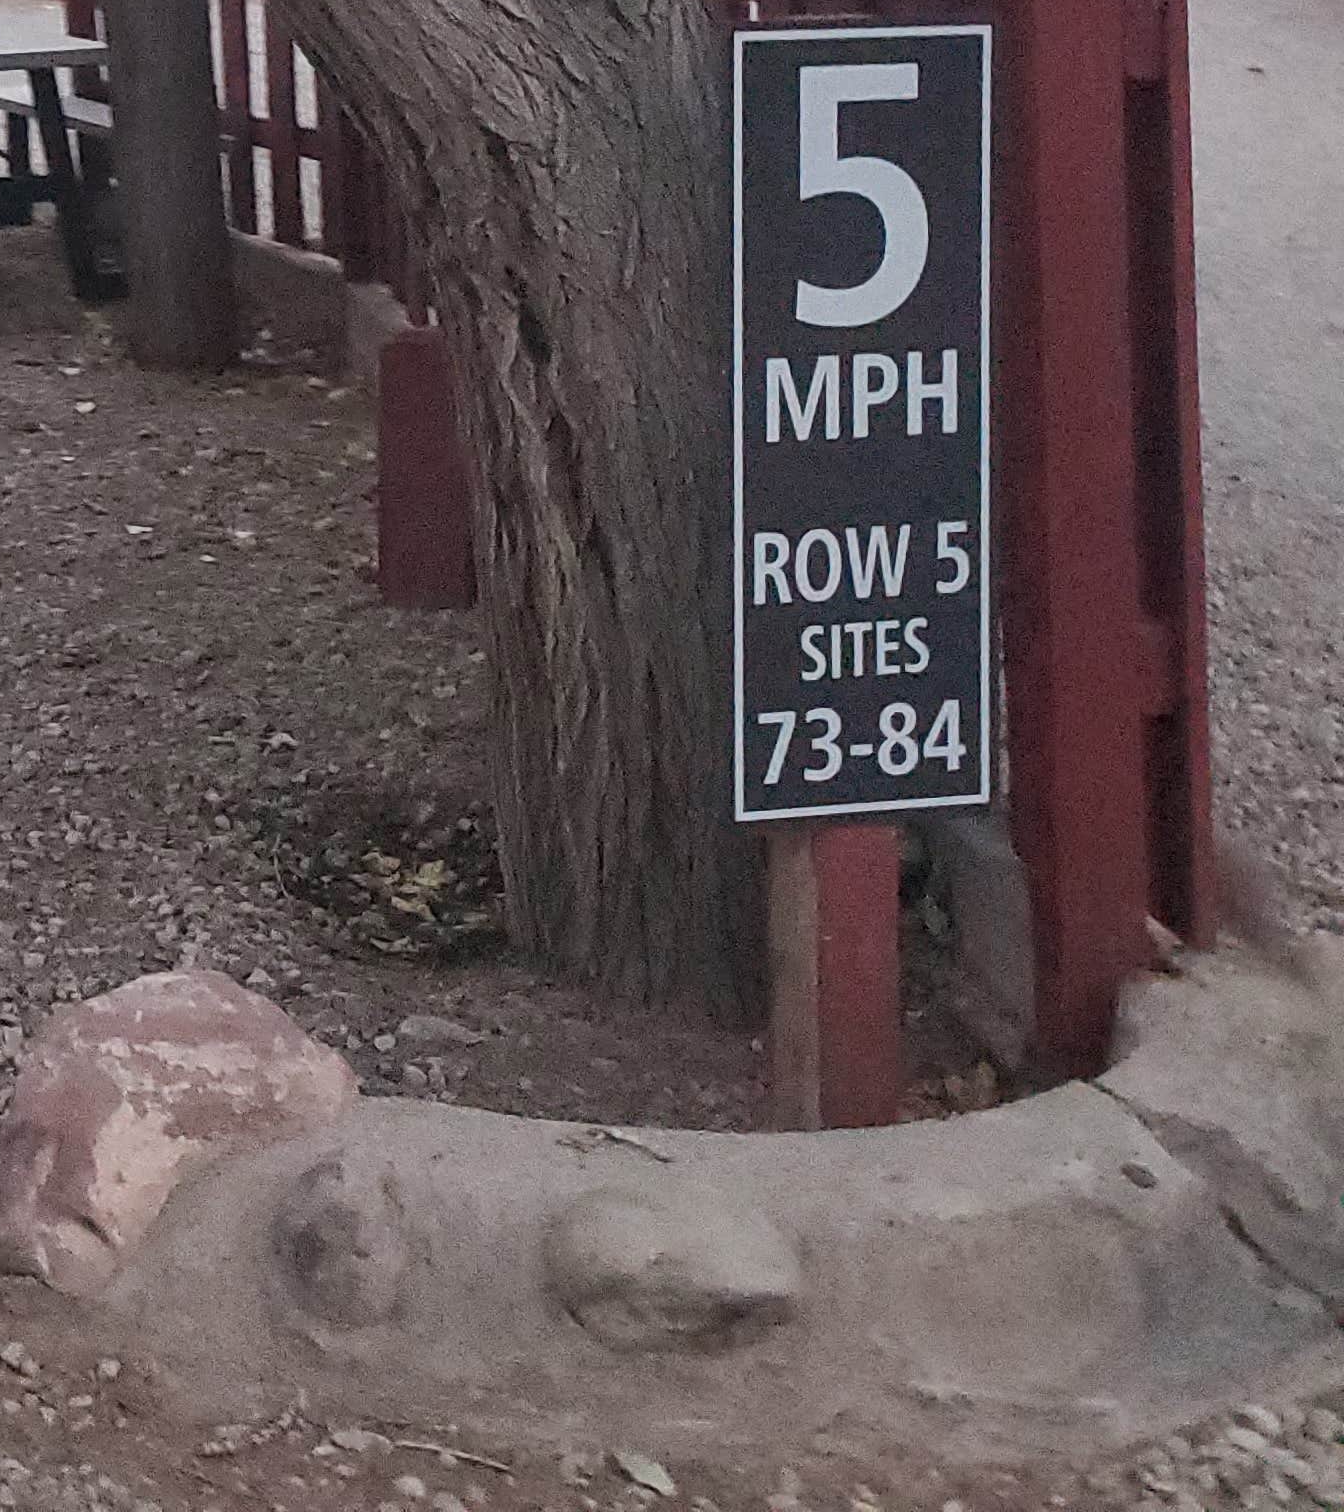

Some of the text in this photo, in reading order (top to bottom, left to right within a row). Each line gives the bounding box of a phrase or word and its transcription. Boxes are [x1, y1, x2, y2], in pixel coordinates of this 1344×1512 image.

[795, 62, 930, 327] 5
[765, 349, 959, 443] MPH
[752, 520, 971, 606] ROW 5
[799, 617, 931, 681] SITES
[756, 699, 968, 785] 73-84
